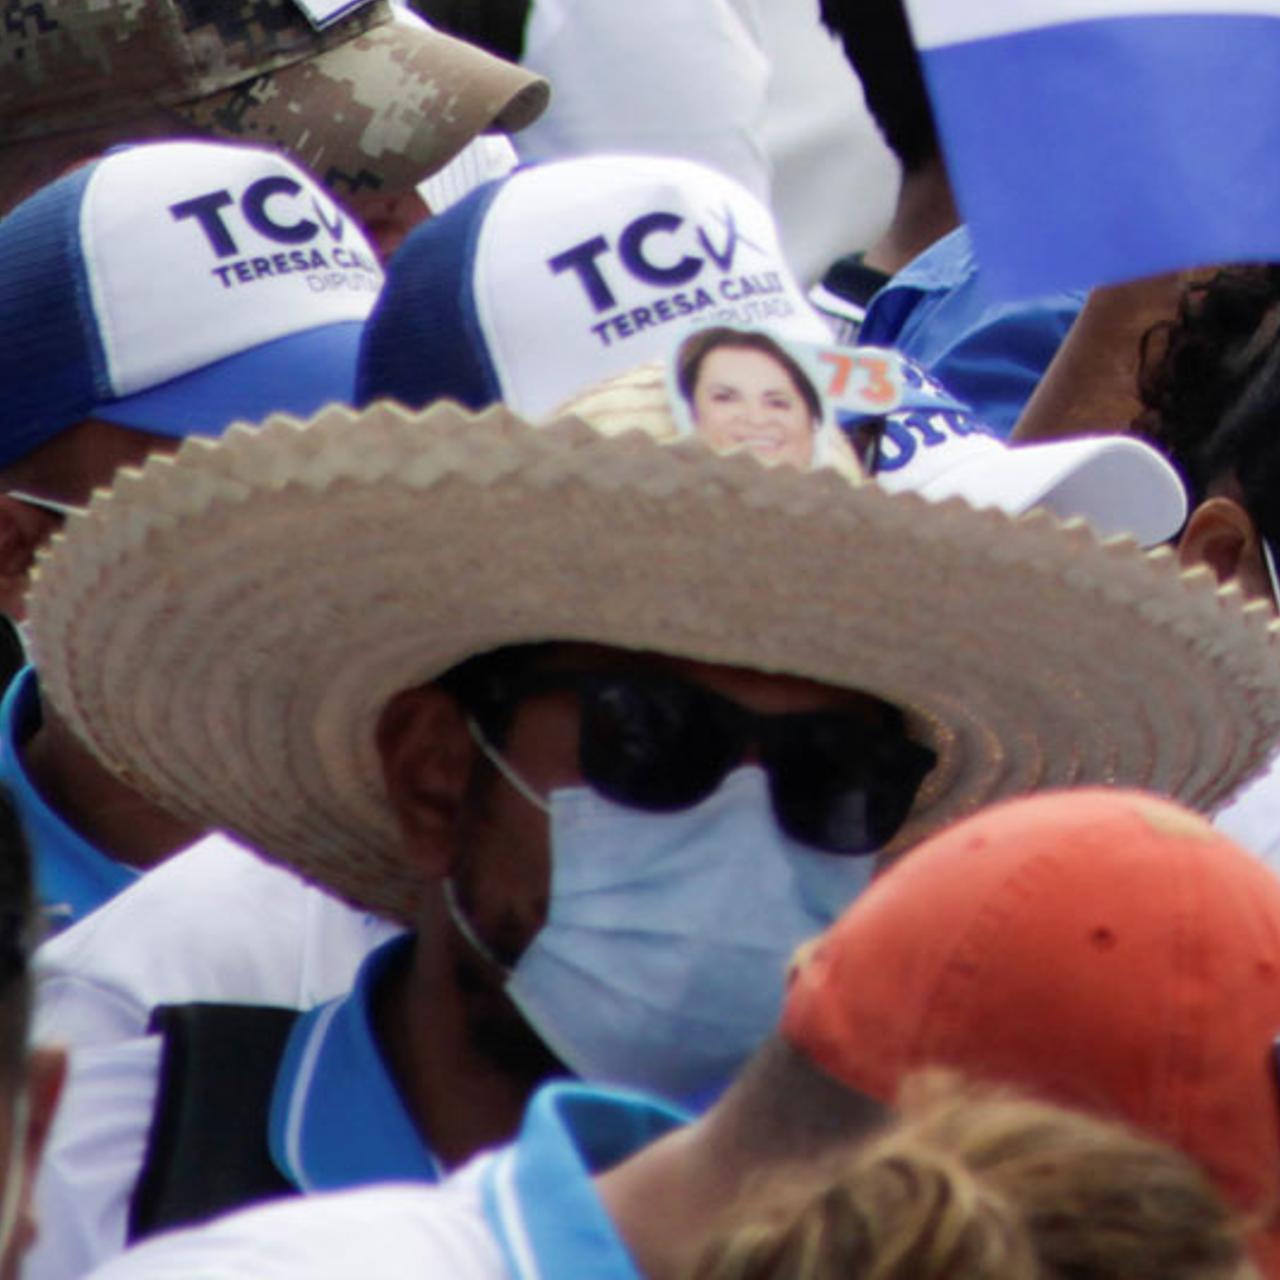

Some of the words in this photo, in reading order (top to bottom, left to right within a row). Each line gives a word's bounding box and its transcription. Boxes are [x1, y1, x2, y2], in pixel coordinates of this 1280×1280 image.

[211, 249, 329, 289] TERESA
[591, 287, 715, 347] TERESA
[820, 352, 896, 404] 73
